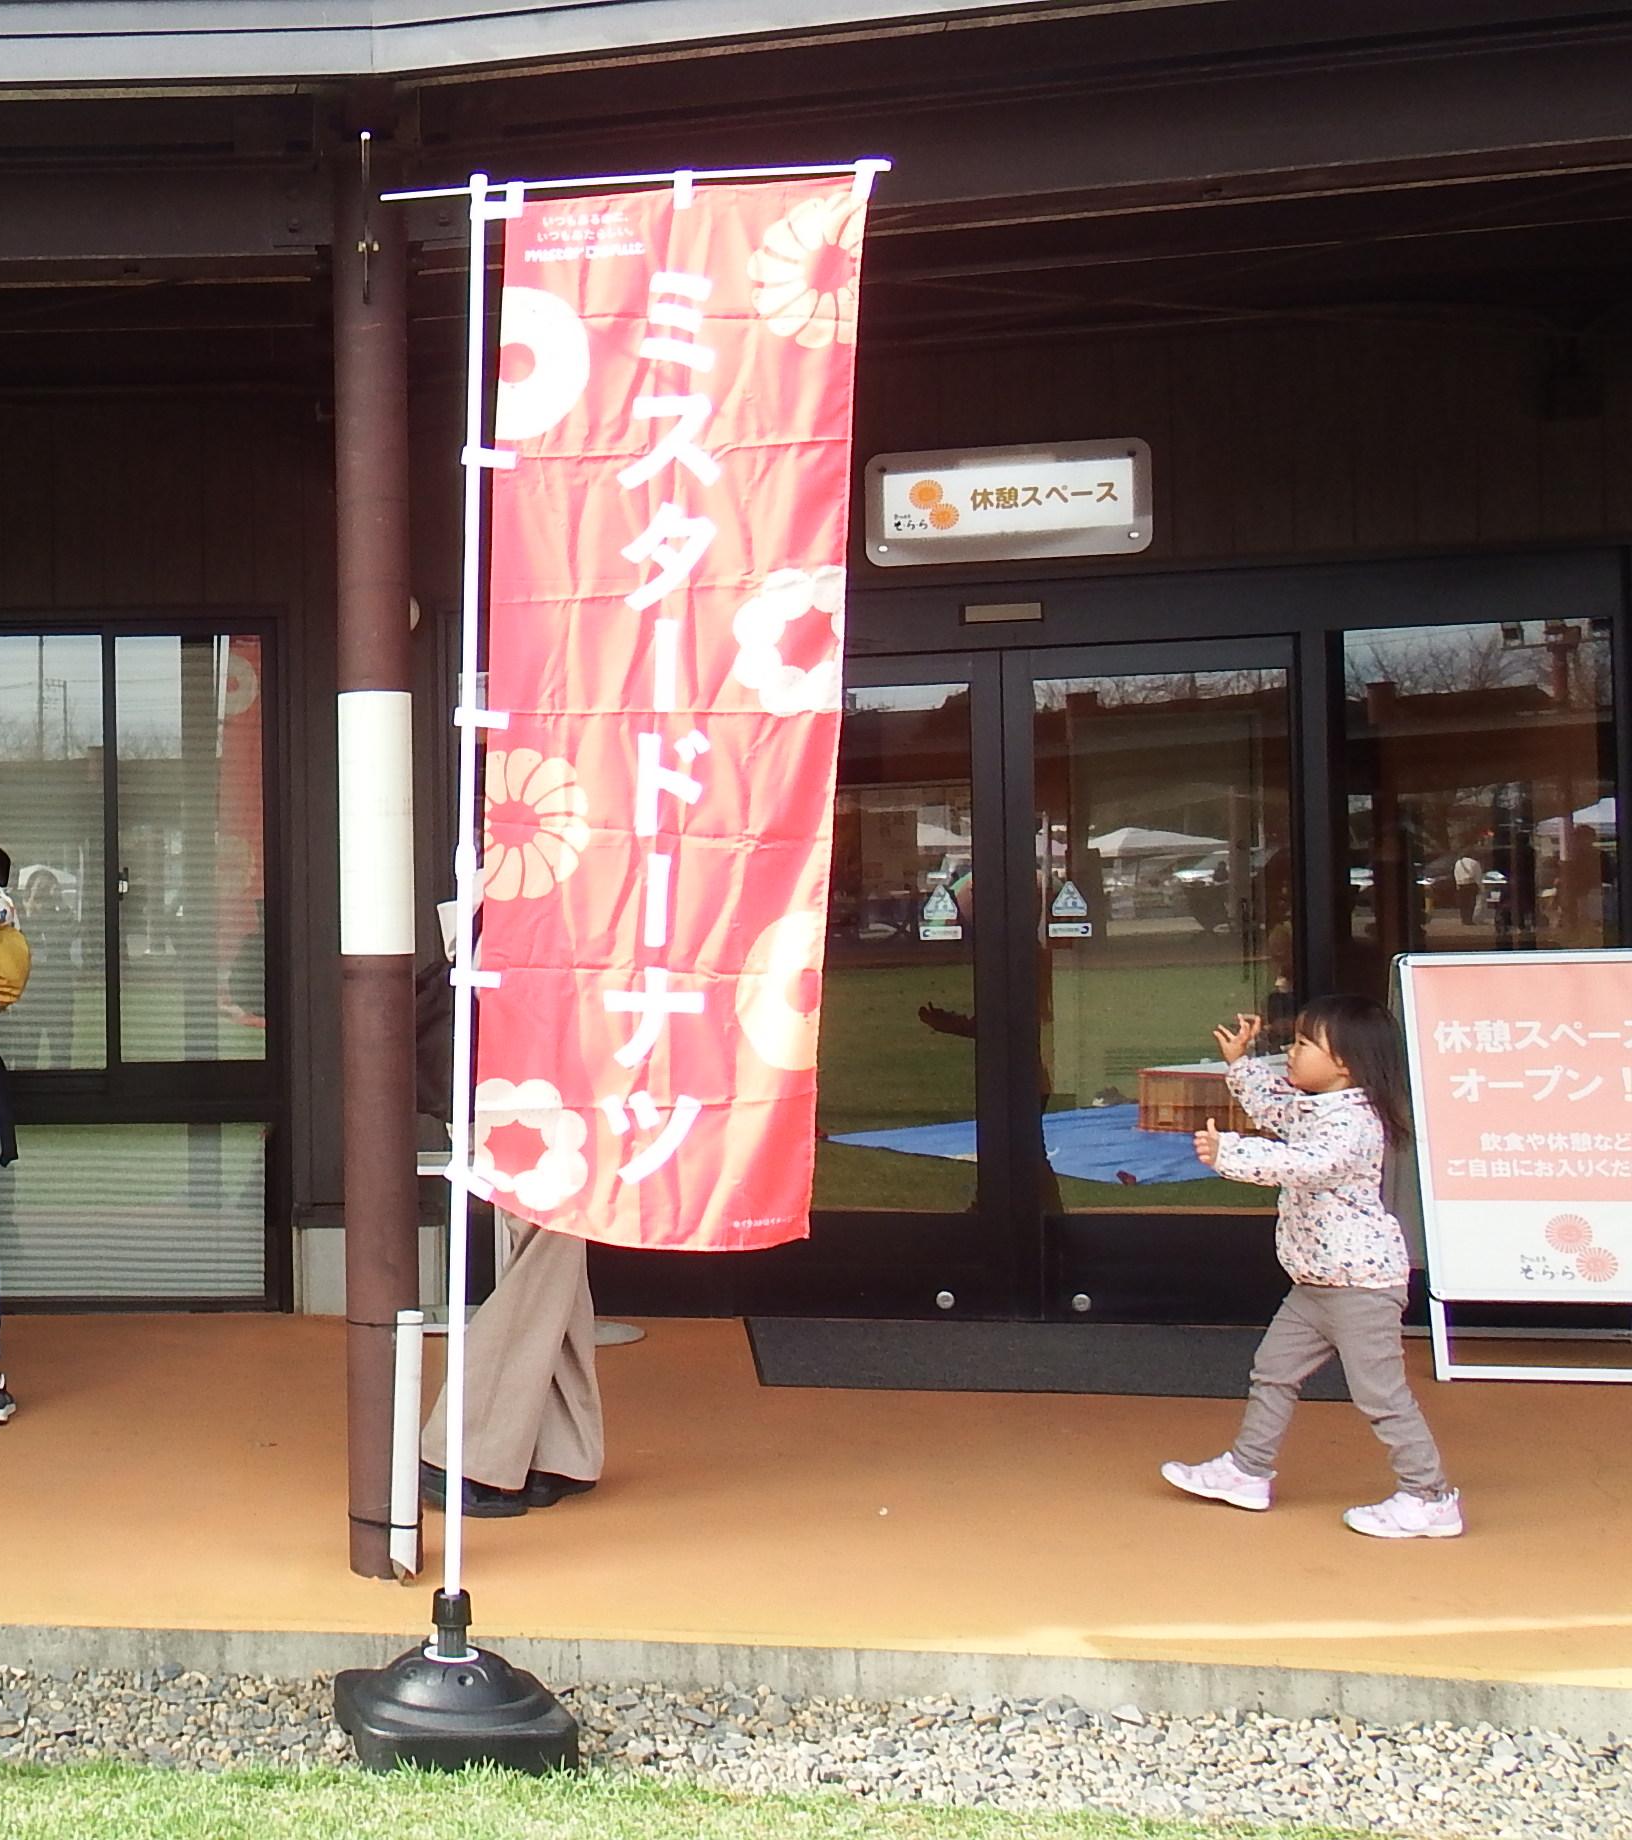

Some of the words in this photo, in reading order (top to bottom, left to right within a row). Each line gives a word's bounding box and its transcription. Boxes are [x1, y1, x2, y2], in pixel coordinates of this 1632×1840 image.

[970, 482, 1118, 511] 休憩スペース
[603, 270, 722, 1185] ミスタードーナツ
[1480, 1132, 1632, 1153] 飲食や休憩など
[1447, 1158, 1632, 1178] ご自由にお入りくだ
